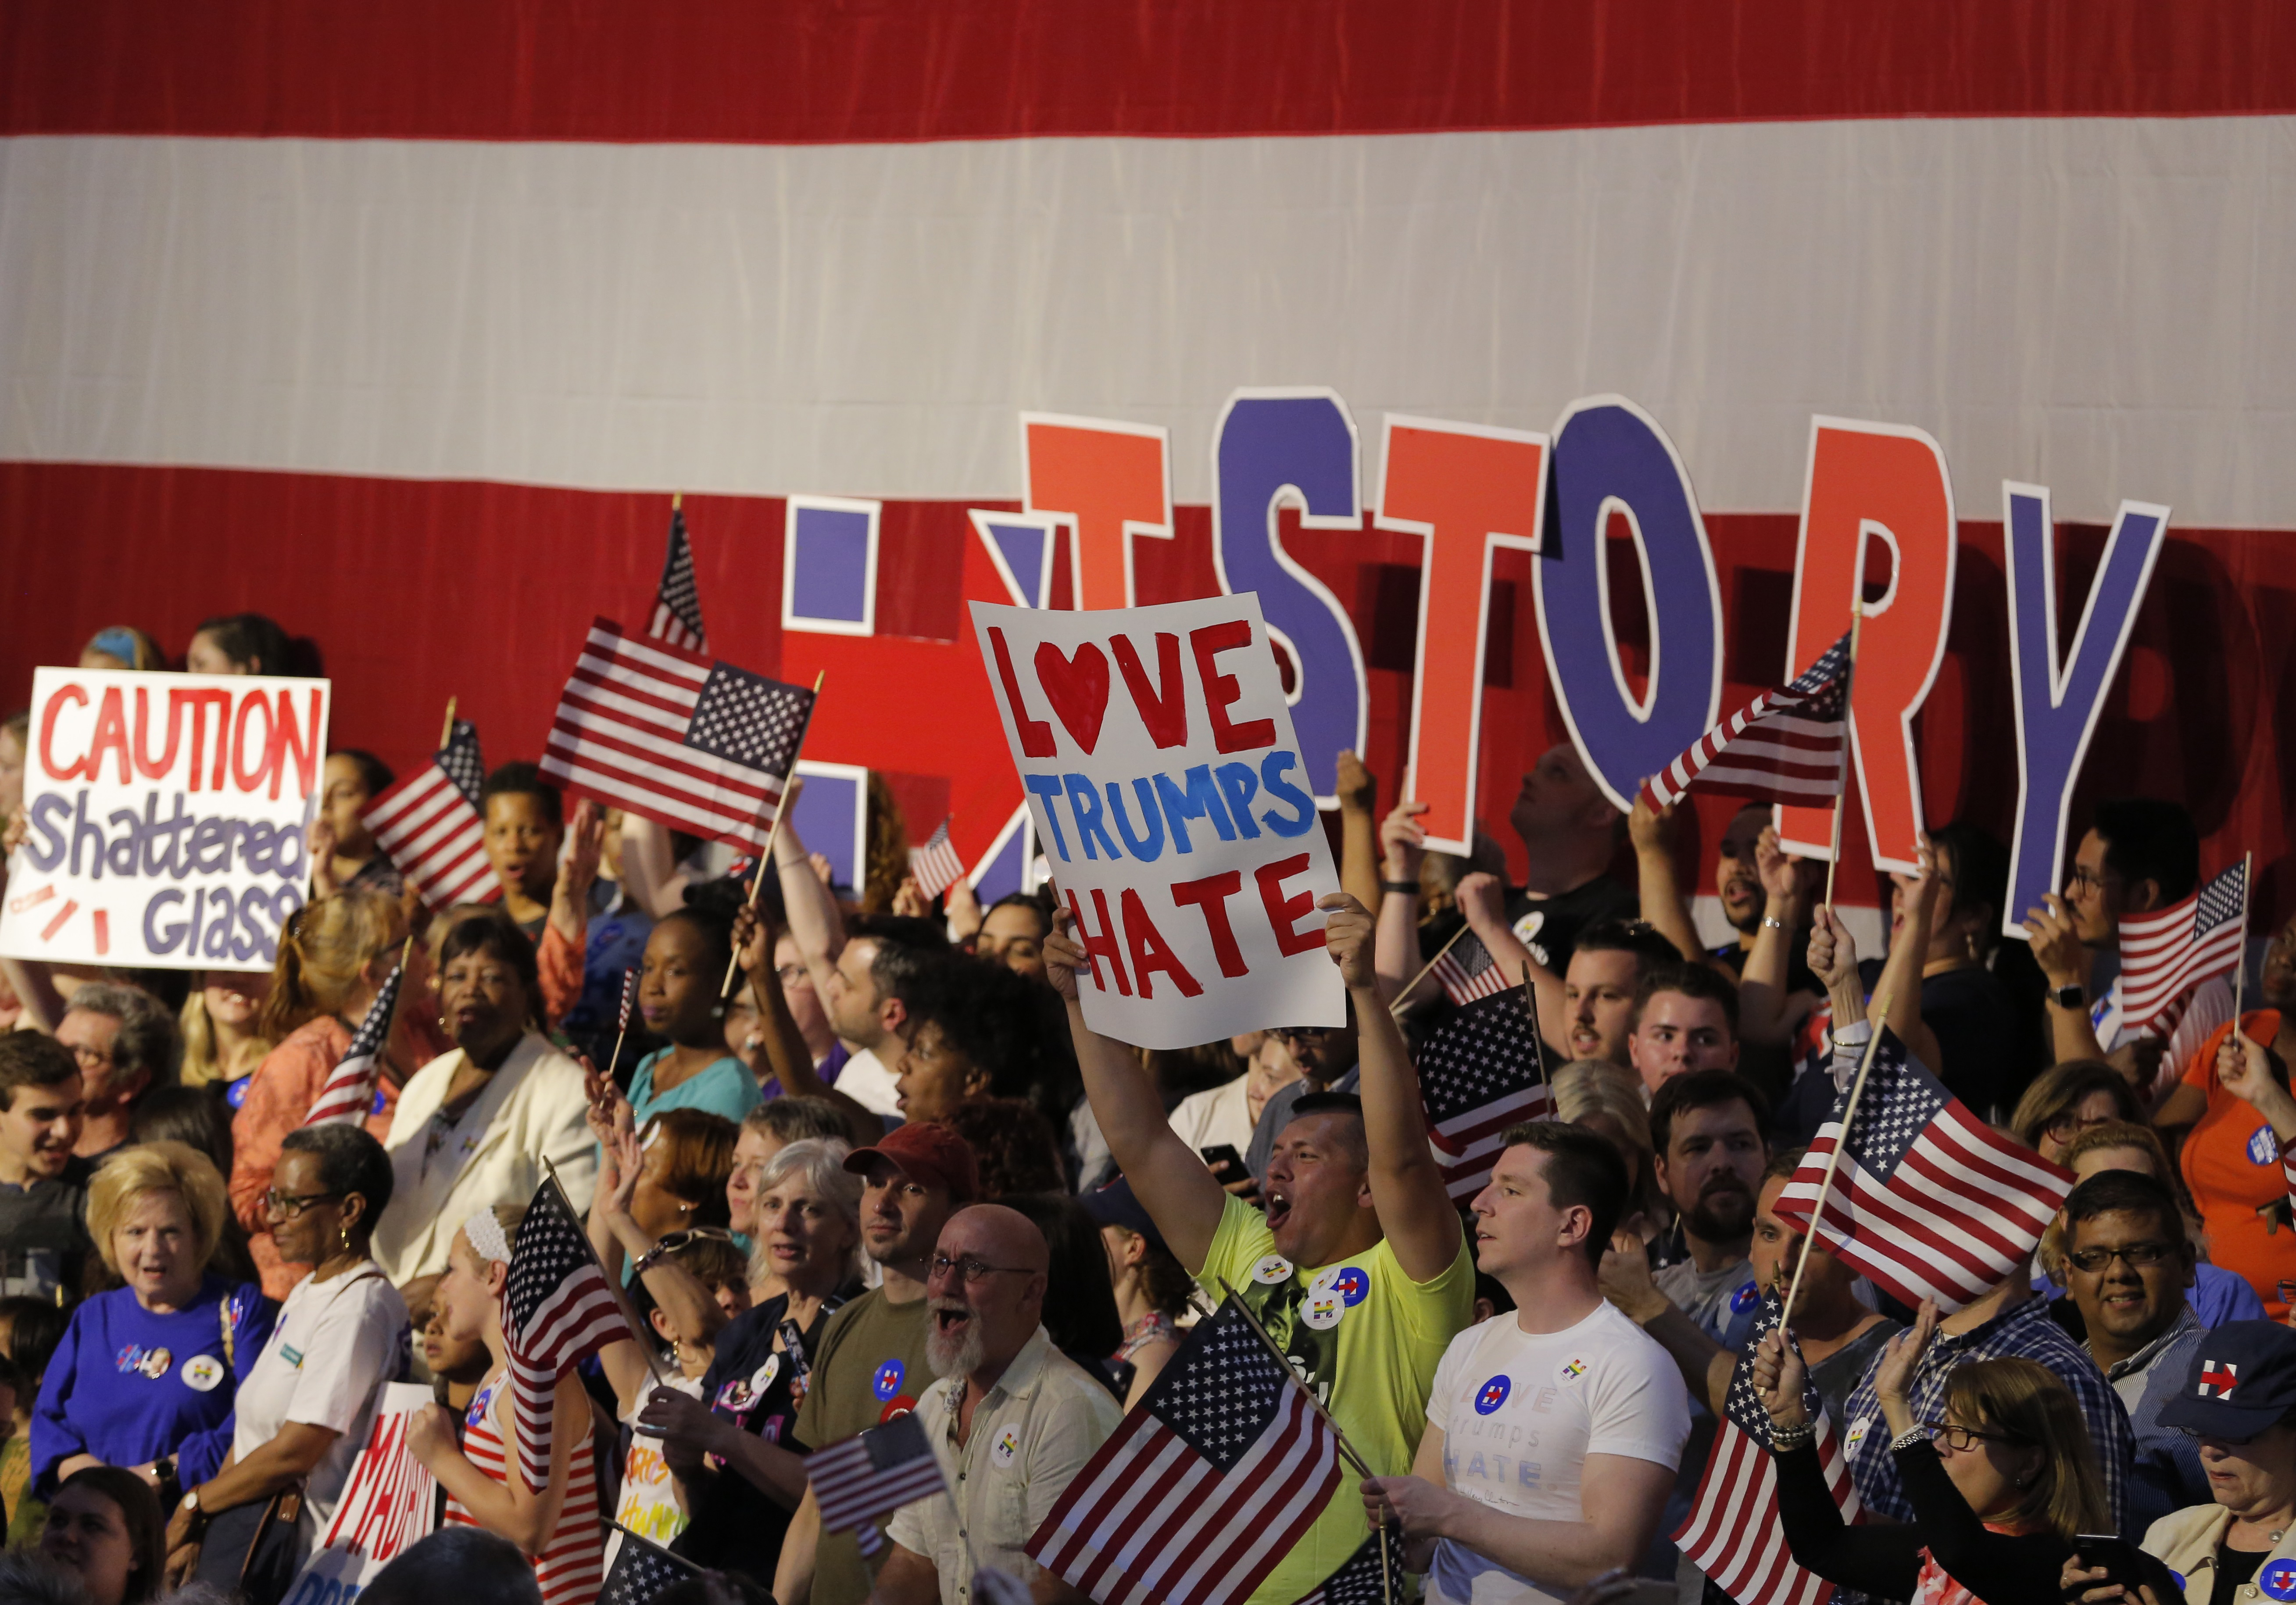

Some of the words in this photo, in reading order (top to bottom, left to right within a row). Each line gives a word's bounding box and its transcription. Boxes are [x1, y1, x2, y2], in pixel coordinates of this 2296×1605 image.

[39, 683, 322, 801] CAUTION
[26, 790, 318, 880] Shattered
[1024, 751, 1315, 863] TRUMPS
[1066, 852, 1327, 1000] HATE
